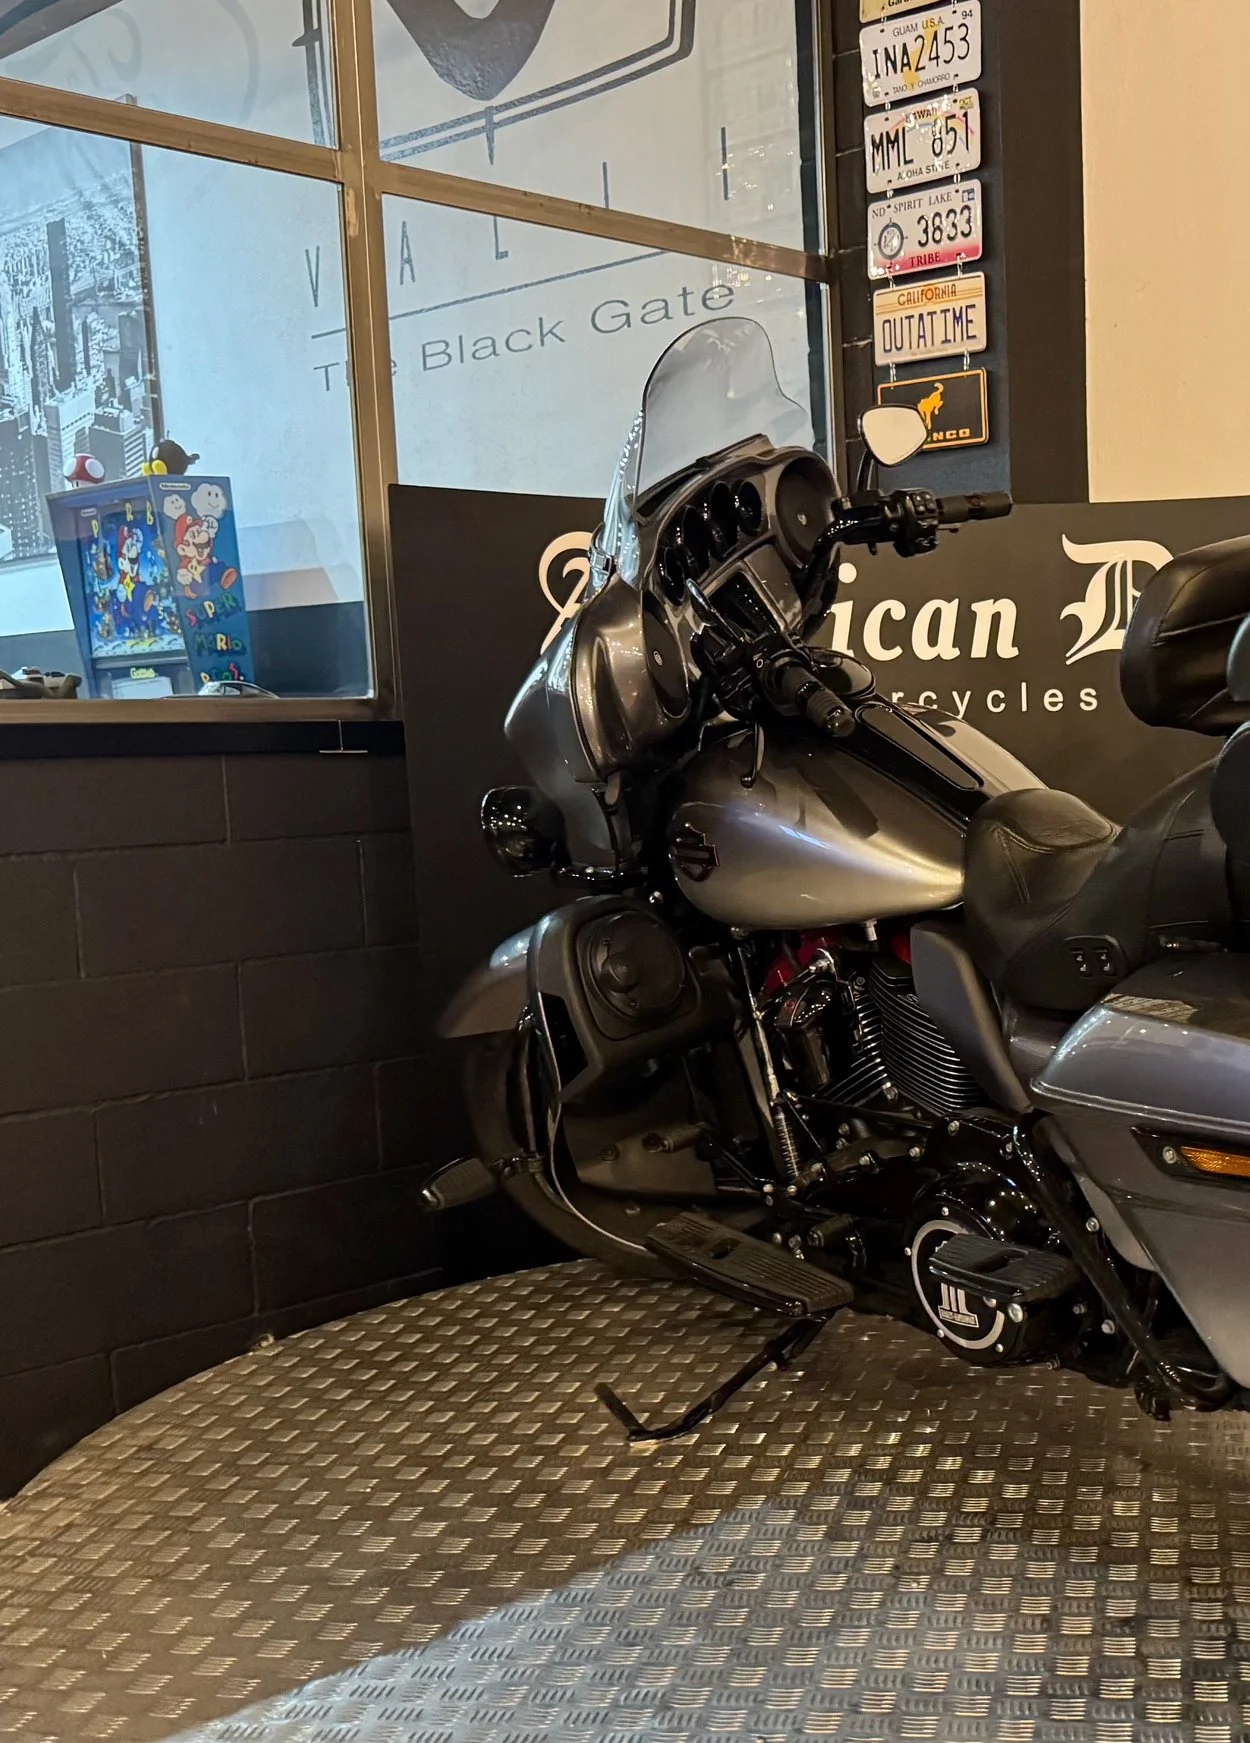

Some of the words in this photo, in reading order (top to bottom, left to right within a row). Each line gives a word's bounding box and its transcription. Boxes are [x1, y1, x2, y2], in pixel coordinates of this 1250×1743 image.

[961, 9, 974, 20] 94
[892, 22, 919, 38] GUAM
[871, 126, 914, 174] MML
[931, 111, 971, 159] 851
[872, 207, 887, 221] ND
[893, 199, 924, 215] SPIRIT
[928, 191, 953, 206] LAKE
[917, 204, 974, 248] 3833
[909, 252, 942, 269] TRIBE
[897, 283, 958, 307] CALIFORNIA
[421, 316, 568, 372] Black
[590, 283, 736, 335] Gate
[882, 304, 978, 354] OUTATIME
